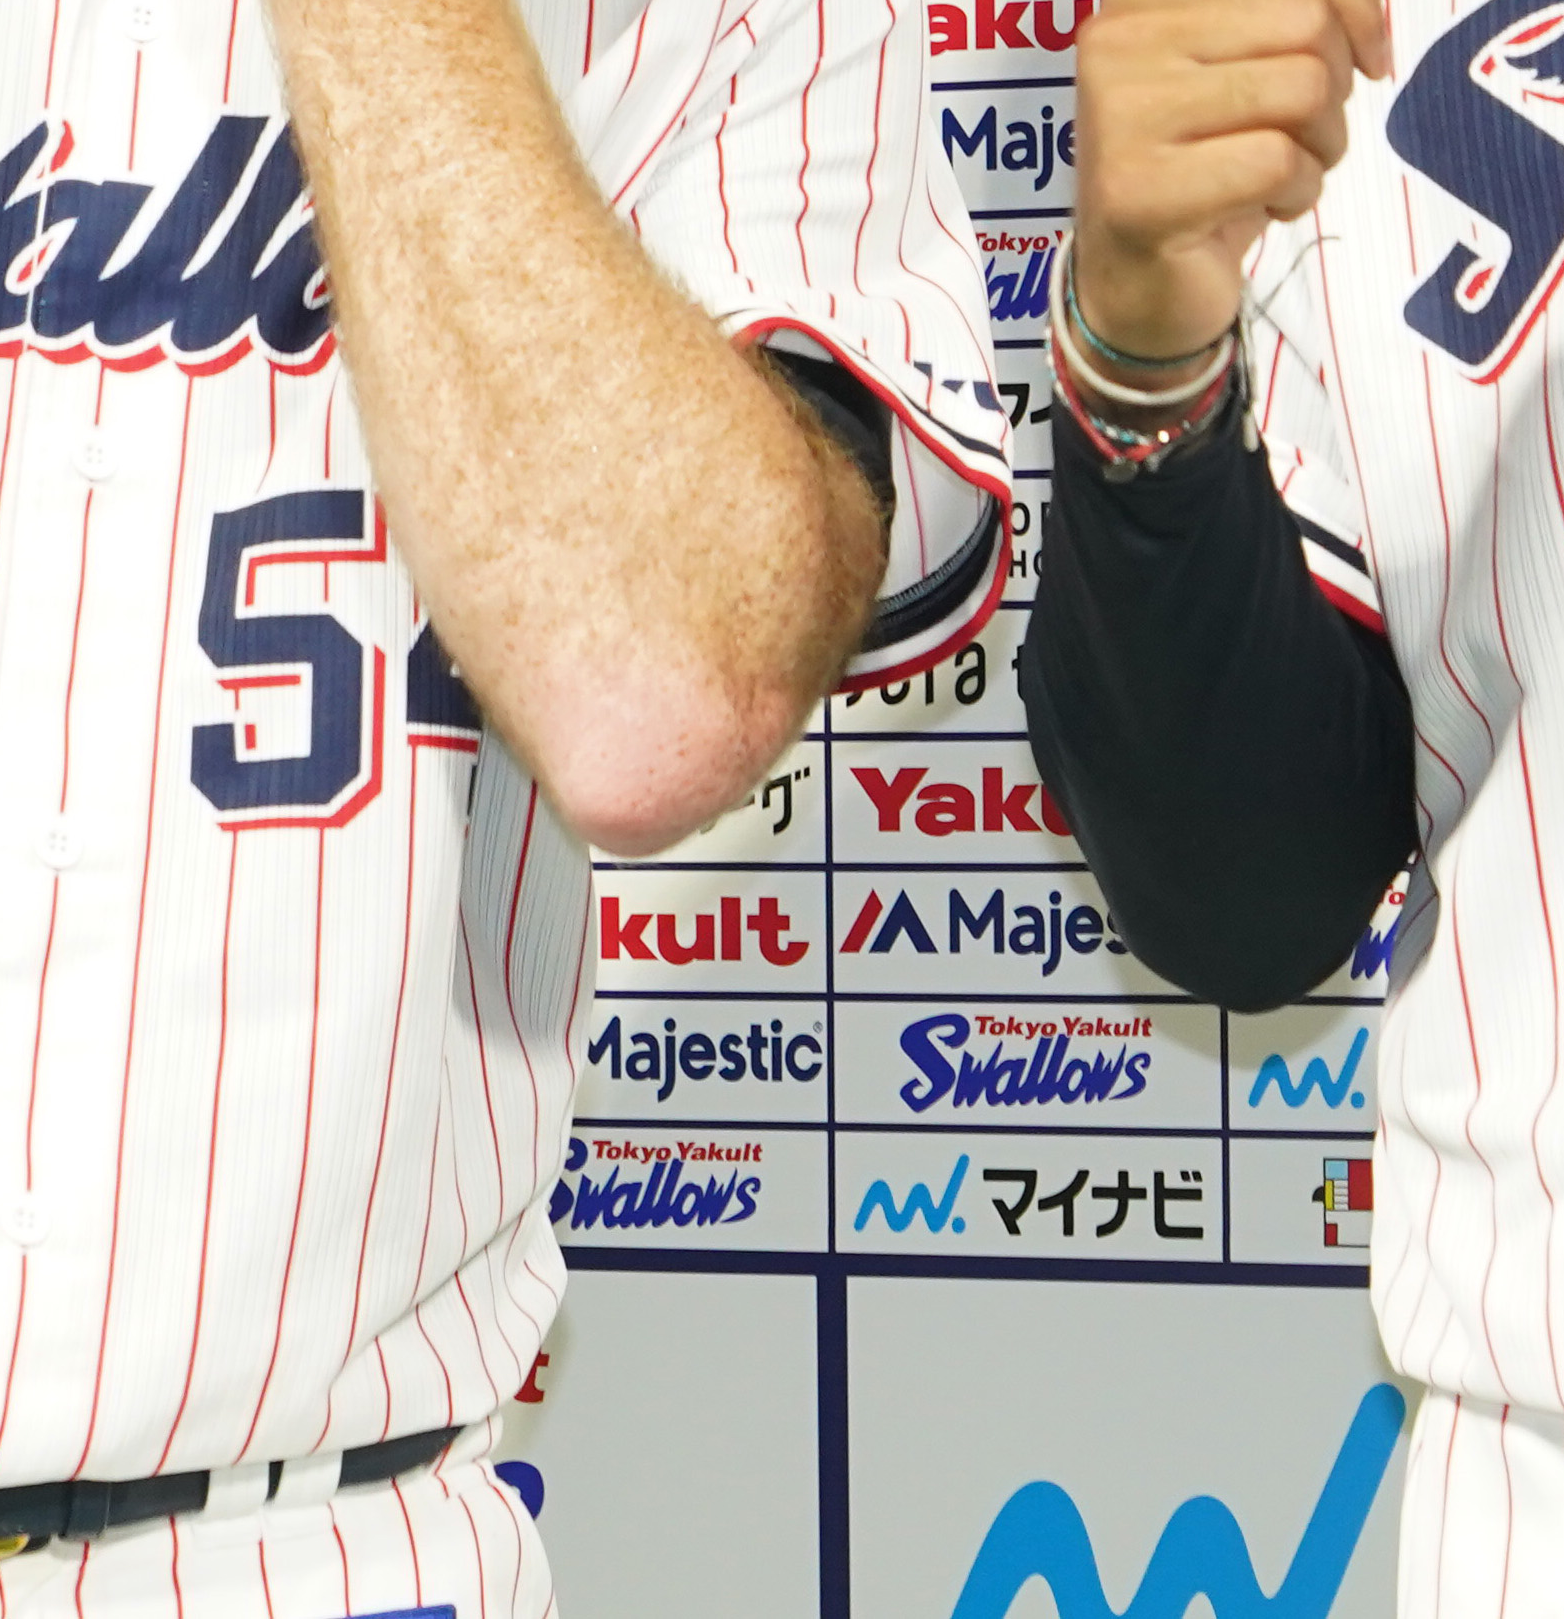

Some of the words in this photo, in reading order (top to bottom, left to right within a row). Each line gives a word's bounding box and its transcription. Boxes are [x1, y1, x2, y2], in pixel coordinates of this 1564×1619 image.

[588, 1002, 826, 1105] Majestic
[898, 1012, 1152, 1113] Swallows
[974, 1015, 1059, 1041] Tokyo
[1062, 1016, 1153, 1038] Yakult
[591, 1139, 673, 1165] Tokyo
[676, 1141, 763, 1163] Yakult
[982, 1168, 1204, 1240] マイナビ
